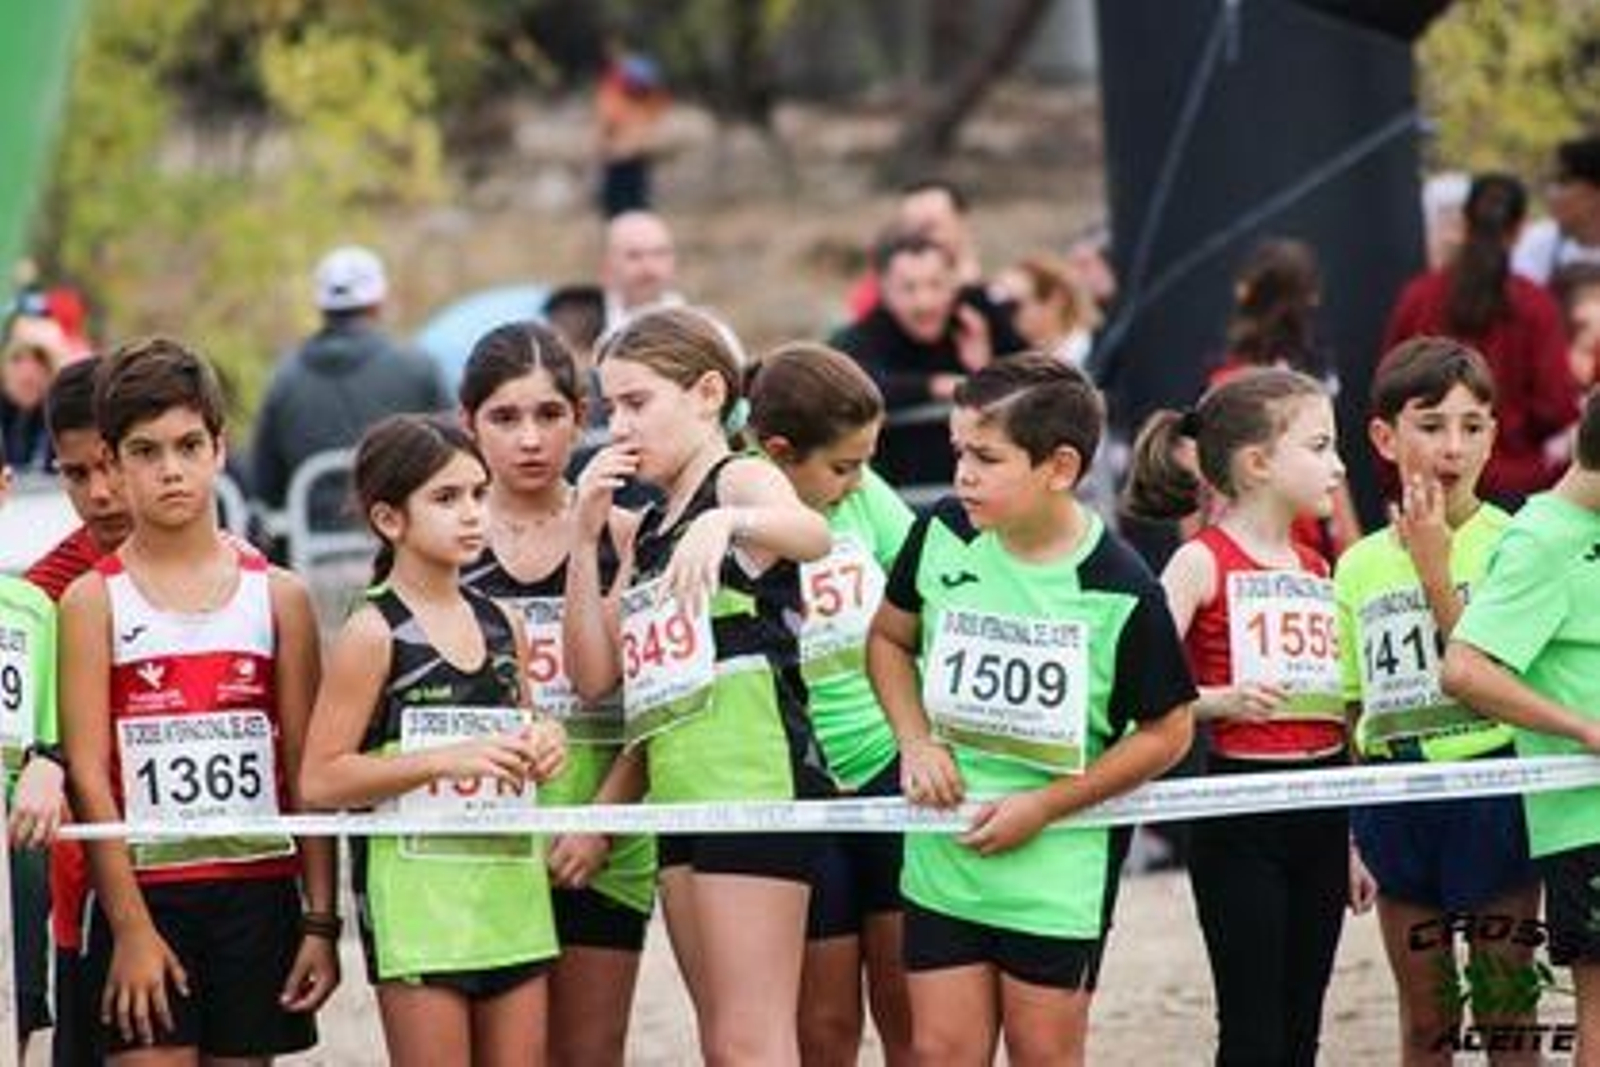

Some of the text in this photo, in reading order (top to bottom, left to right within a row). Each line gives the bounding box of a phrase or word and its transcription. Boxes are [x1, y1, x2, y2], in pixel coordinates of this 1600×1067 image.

[799, 566, 863, 621] 57
[1, 664, 23, 711] 9
[944, 648, 1068, 710] 1509
[136, 751, 262, 806] 1365
